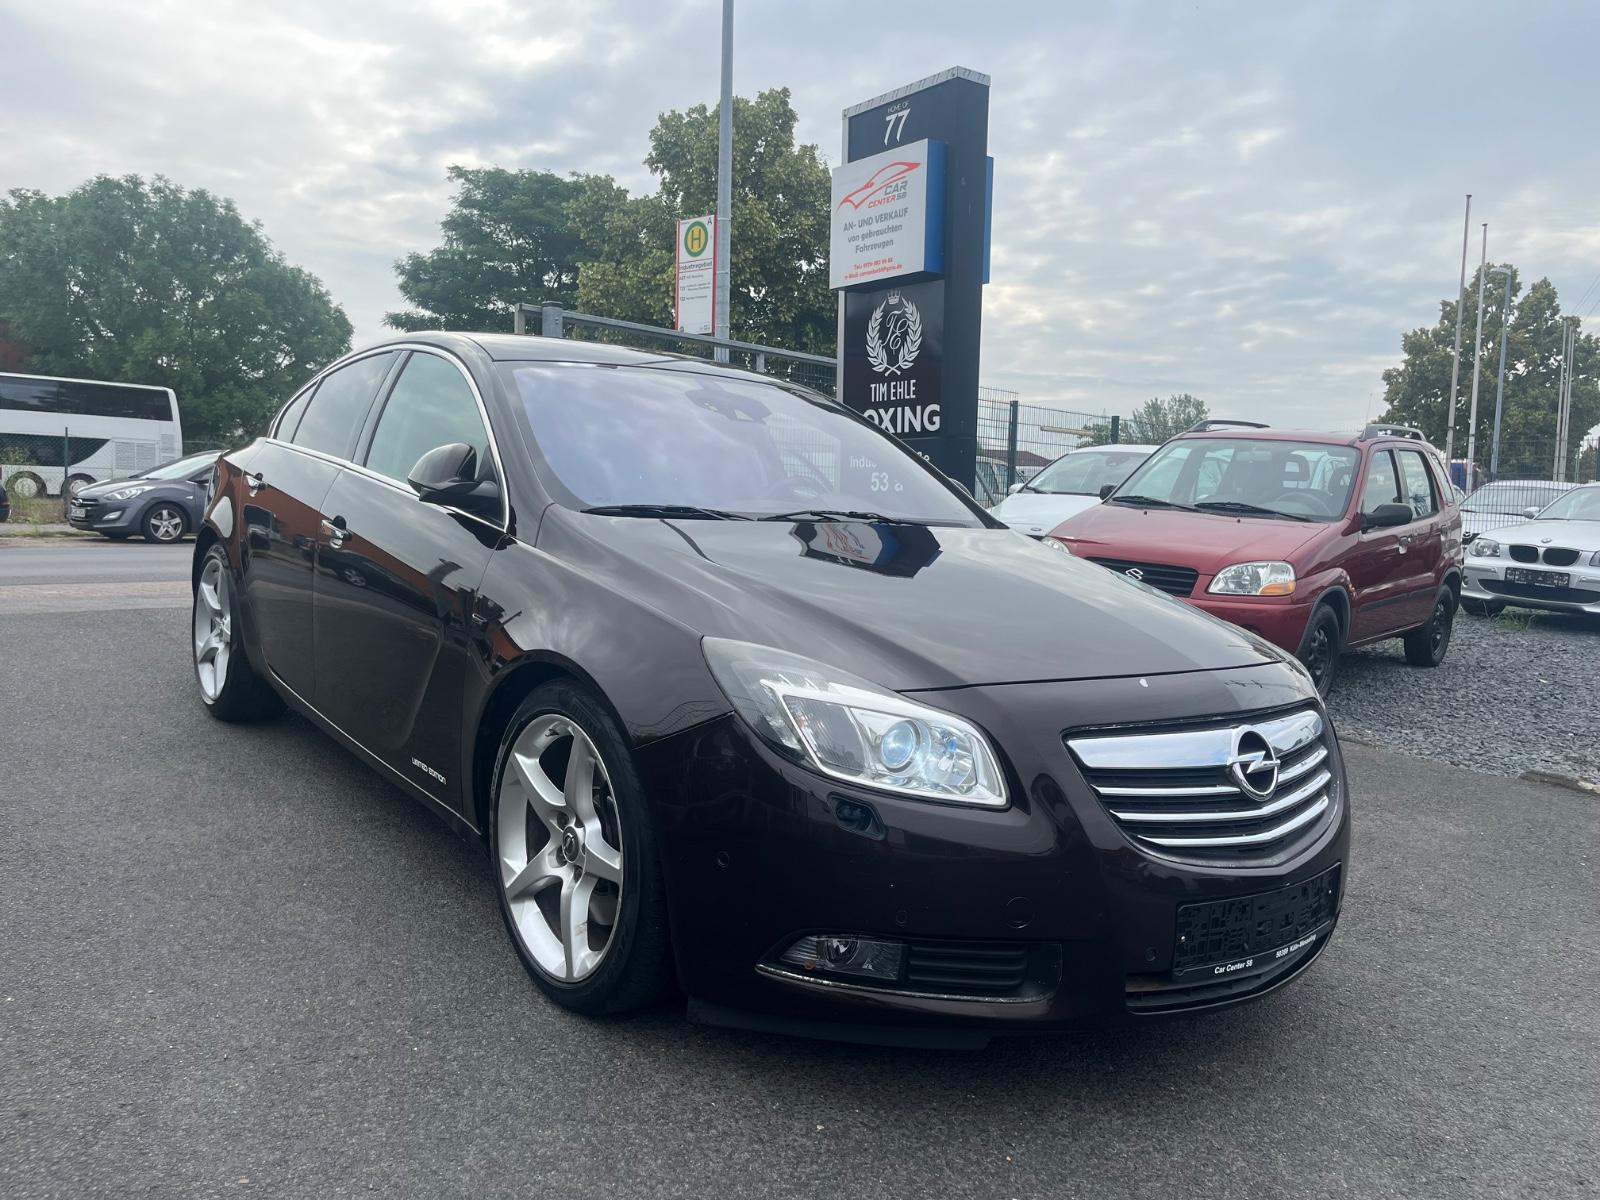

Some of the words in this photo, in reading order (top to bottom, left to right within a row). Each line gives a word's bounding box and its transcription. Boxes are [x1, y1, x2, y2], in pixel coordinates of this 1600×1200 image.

[888, 104, 901, 113] HOME
[902, 101, 910, 109] OF
[884, 108, 910, 146] 77
[884, 181, 908, 196] CAR
[867, 195, 895, 209] CENTER
[707, 217, 712, 226] A
[843, 220, 856, 232] AN-
[858, 216, 873, 228] UND
[875, 208, 909, 225] VERKAUF
[692, 229, 701, 249] H
[848, 232, 859, 242] von
[861, 223, 903, 241] gebrauchten
[855, 239, 894, 254] Fahrzeugen
[870, 382, 887, 402] TIM
[891, 380, 916, 400] EHLE
[871, 472, 889, 491] 53
[1214, 966, 1225, 974] Car
[1226, 963, 1245, 972] Center
